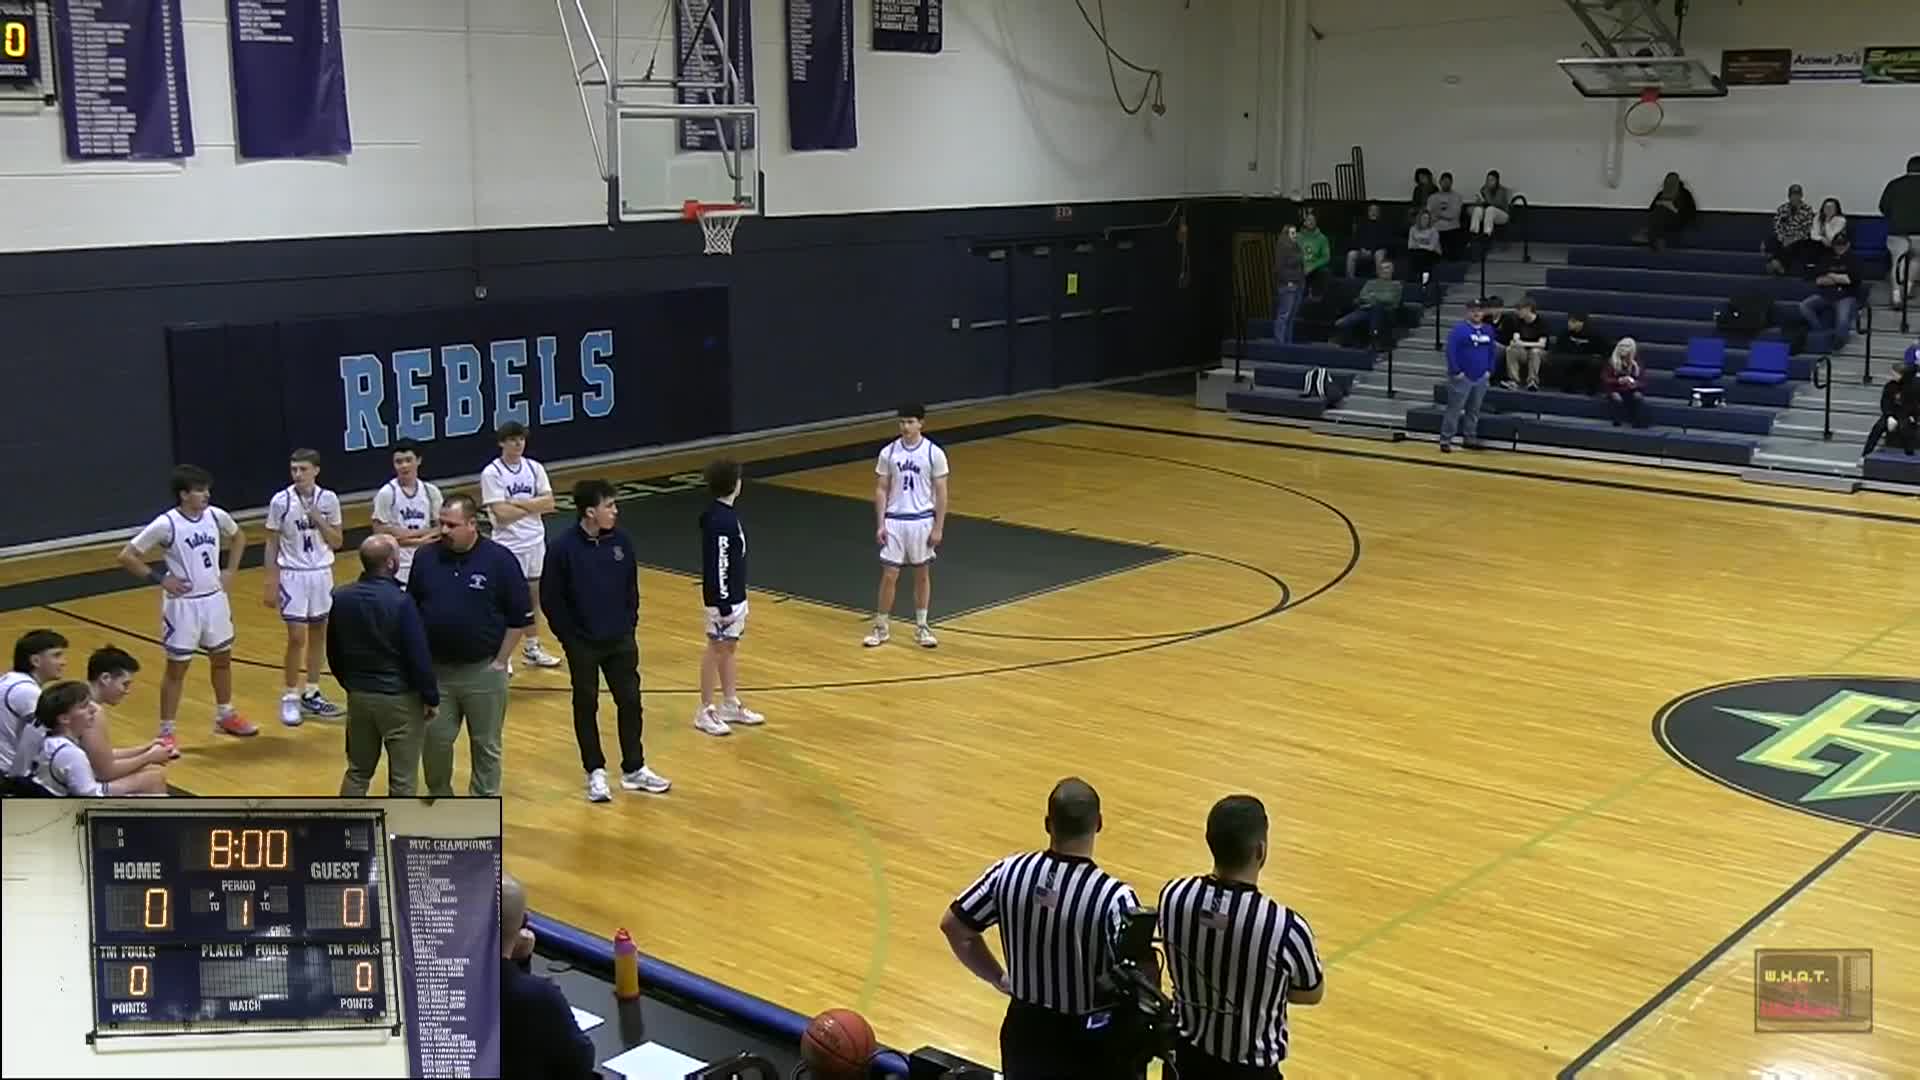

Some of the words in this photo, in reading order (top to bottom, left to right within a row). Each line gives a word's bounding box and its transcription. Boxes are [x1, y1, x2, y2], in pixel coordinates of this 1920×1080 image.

[5, 22, 26, 57] 0
[339, 330, 615, 451] REBELS
[201, 551, 212, 568] 2
[718, 535, 730, 599] REBELS
[210, 829, 288, 868] 8:00
[409, 839, 431, 850] MVC
[433, 840, 493, 851] CHAMPIONS
[113, 861, 161, 880] HOME
[310, 861, 360, 880] GUEST
[221, 880, 256, 892] PERIOD
[145, 888, 168, 928] 0
[242, 899, 249, 926] 1
[343, 887, 364, 928] 0
[100, 946, 117, 959] TM
[121, 946, 156, 959] FOULS
[201, 944, 243, 957] PLAYER
[255, 944, 289, 956] FOULS
[328, 944, 344, 956] TM
[347, 943, 380, 956] FOULS
[129, 965, 148, 996] 0
[356, 961, 372, 992] 0
[112, 1002, 148, 1015] POINTS
[229, 999, 261, 1012] MATCH
[340, 998, 374, 1010] POINTS
